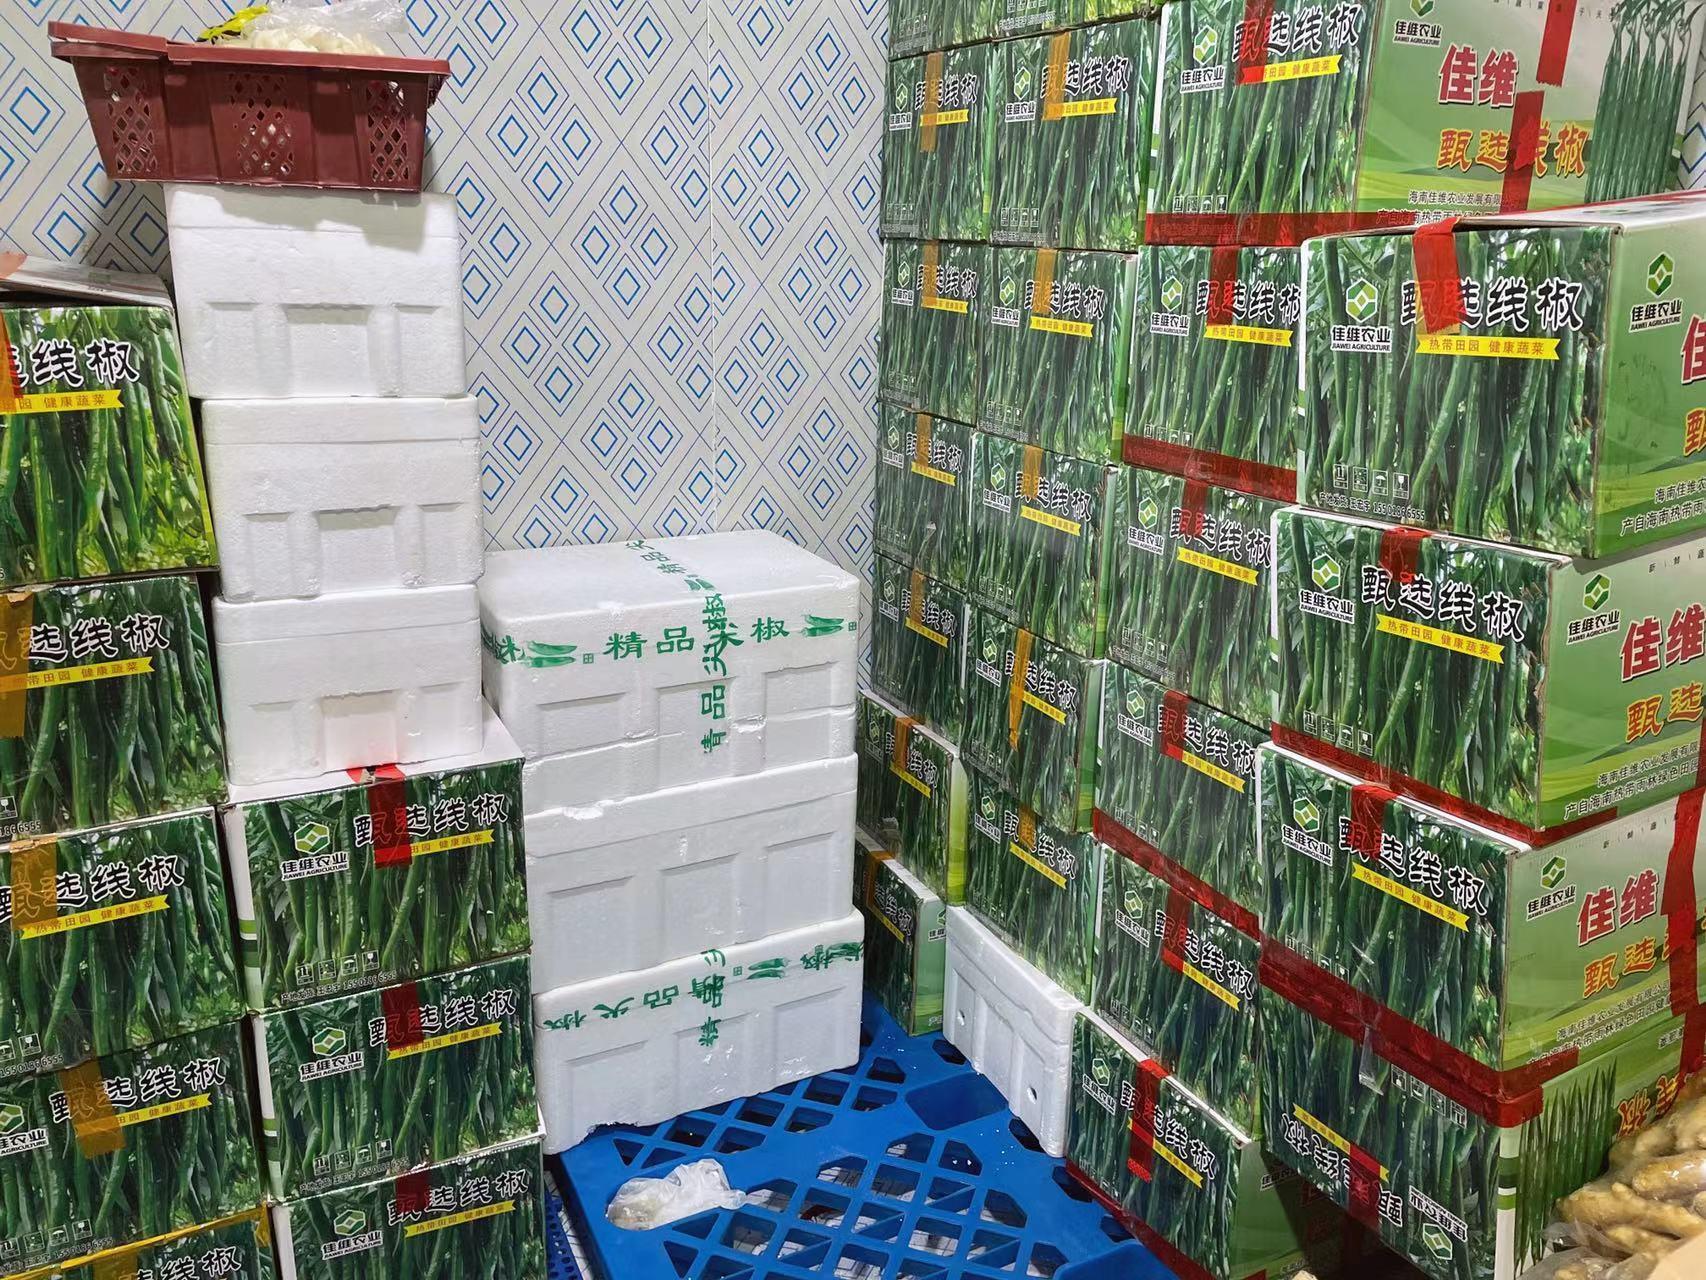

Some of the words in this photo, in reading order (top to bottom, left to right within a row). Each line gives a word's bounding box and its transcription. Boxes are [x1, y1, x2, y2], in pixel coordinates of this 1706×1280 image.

[1232, 3, 1361, 62] 甄选线椒
[1395, 20, 1442, 39] 佳维农业
[1180, 66, 1224, 85] 佳维农业
[1438, 44, 1519, 107] 佳维
[1401, 276, 1585, 332] 甄选线椒
[1630, 300, 1683, 322] 佳维农业
[1151, 313, 1189, 330] 佳维农业
[1331, 324, 1392, 343] 佳维农业
[1630, 320, 1648, 331] JIAWEI
[1648, 315, 1681, 328] AGRICULTURE
[1331, 342, 1352, 350] JIAWEI
[1352, 343, 1391, 352] AGRICULTURE
[1429, 337, 1480, 353] 热带田园
[1488, 341, 1545, 357] 健康蔬菜
[1299, 589, 1355, 616] 佳维农业
[1300, 604, 1318, 614] JIAWEI
[1318, 608, 1355, 623] AGRICULTURE
[1361, 564, 1525, 643] 甄选线椒
[1568, 610, 1621, 636] 佳维农业
[1441, 633, 1491, 658] 健康蔬菜
[1619, 602, 1706, 683] 佳维
[354, 793, 508, 848] 甄选线椒
[1282, 824, 1333, 860] 佳维农业
[281, 851, 348, 874] 佳维农业
[1338, 815, 1488, 917] 甄选线椒
[1527, 884, 1577, 917] 佳维农业
[1576, 867, 1660, 948] 佳维
[369, 989, 516, 1047] 甄选线椒
[301, 1052, 364, 1076] 佳维农业
[388, 1169, 528, 1226] 甄选线椒
[323, 1231, 383, 1254] 佳维农业
